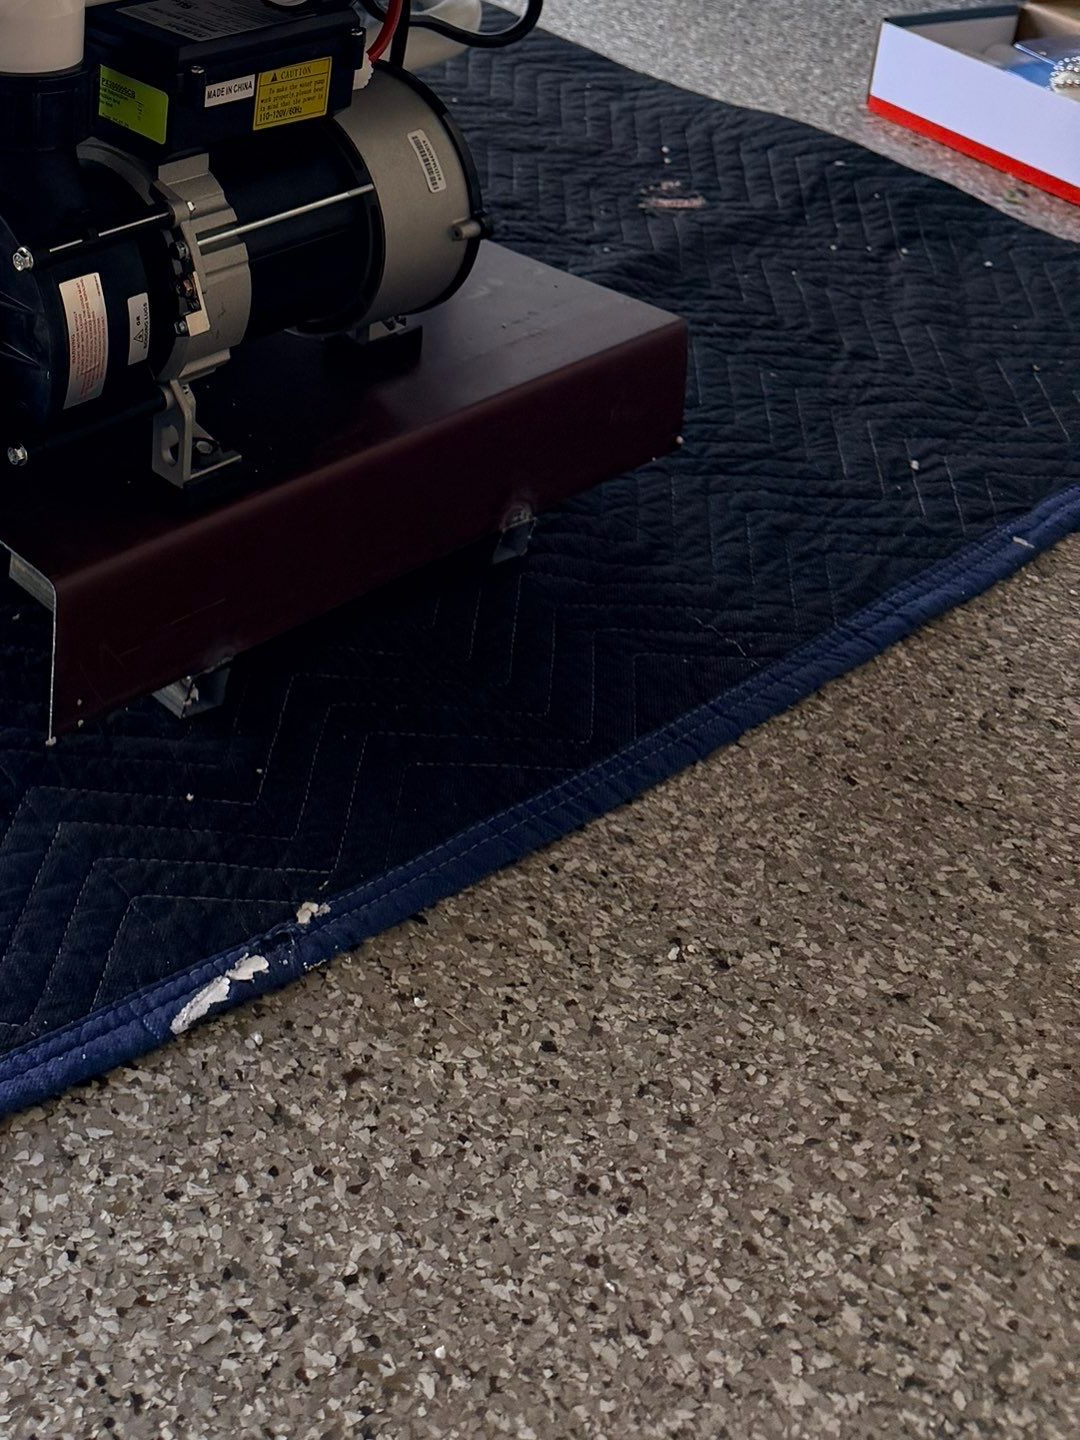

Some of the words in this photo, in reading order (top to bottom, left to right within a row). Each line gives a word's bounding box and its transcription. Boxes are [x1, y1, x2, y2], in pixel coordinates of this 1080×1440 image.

[280, 65, 312, 80] CAUTION
[207, 87, 225, 99] MADE
[226, 85, 233, 95] IN
[233, 80, 253, 93] CHINA
